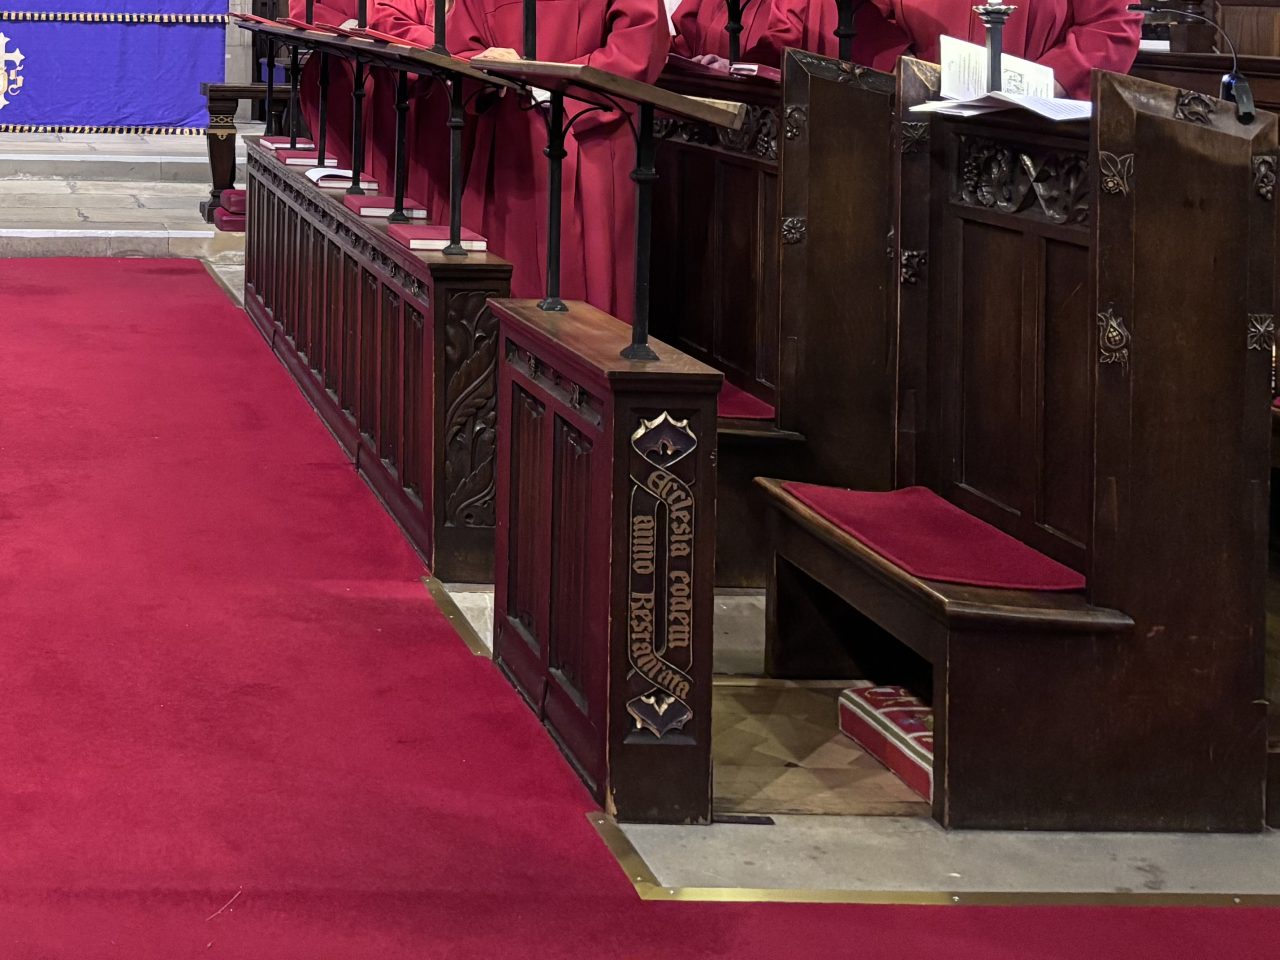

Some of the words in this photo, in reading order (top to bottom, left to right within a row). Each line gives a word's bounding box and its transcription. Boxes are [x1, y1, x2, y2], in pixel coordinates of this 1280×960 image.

[632, 515, 655, 575] anno
[647, 470, 693, 558] Ecclesia
[668, 570, 692, 649] eodem
